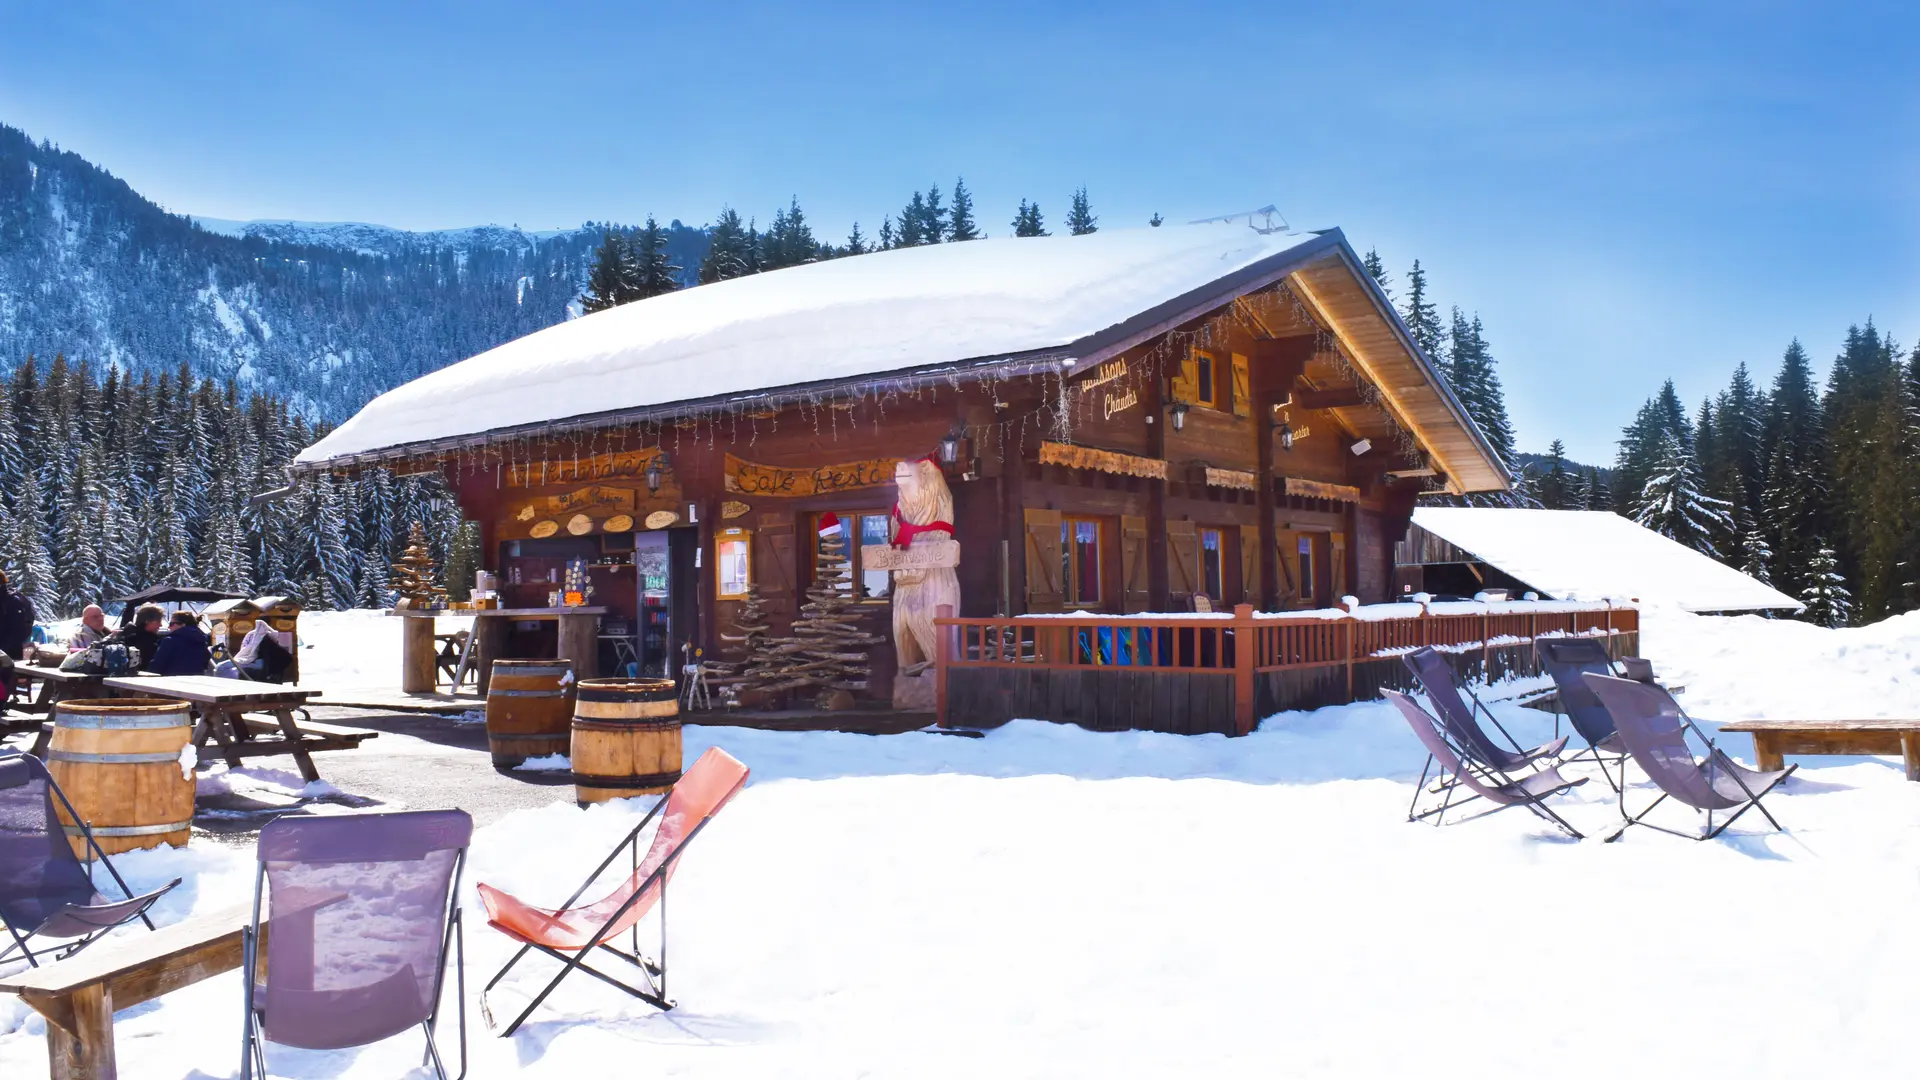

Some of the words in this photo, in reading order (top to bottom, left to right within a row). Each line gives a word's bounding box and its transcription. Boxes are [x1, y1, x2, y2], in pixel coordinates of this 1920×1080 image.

[1104, 387, 1138, 421] Chaudes
[736, 465, 796, 496] Café
[872, 548, 946, 569] Bienvenue
